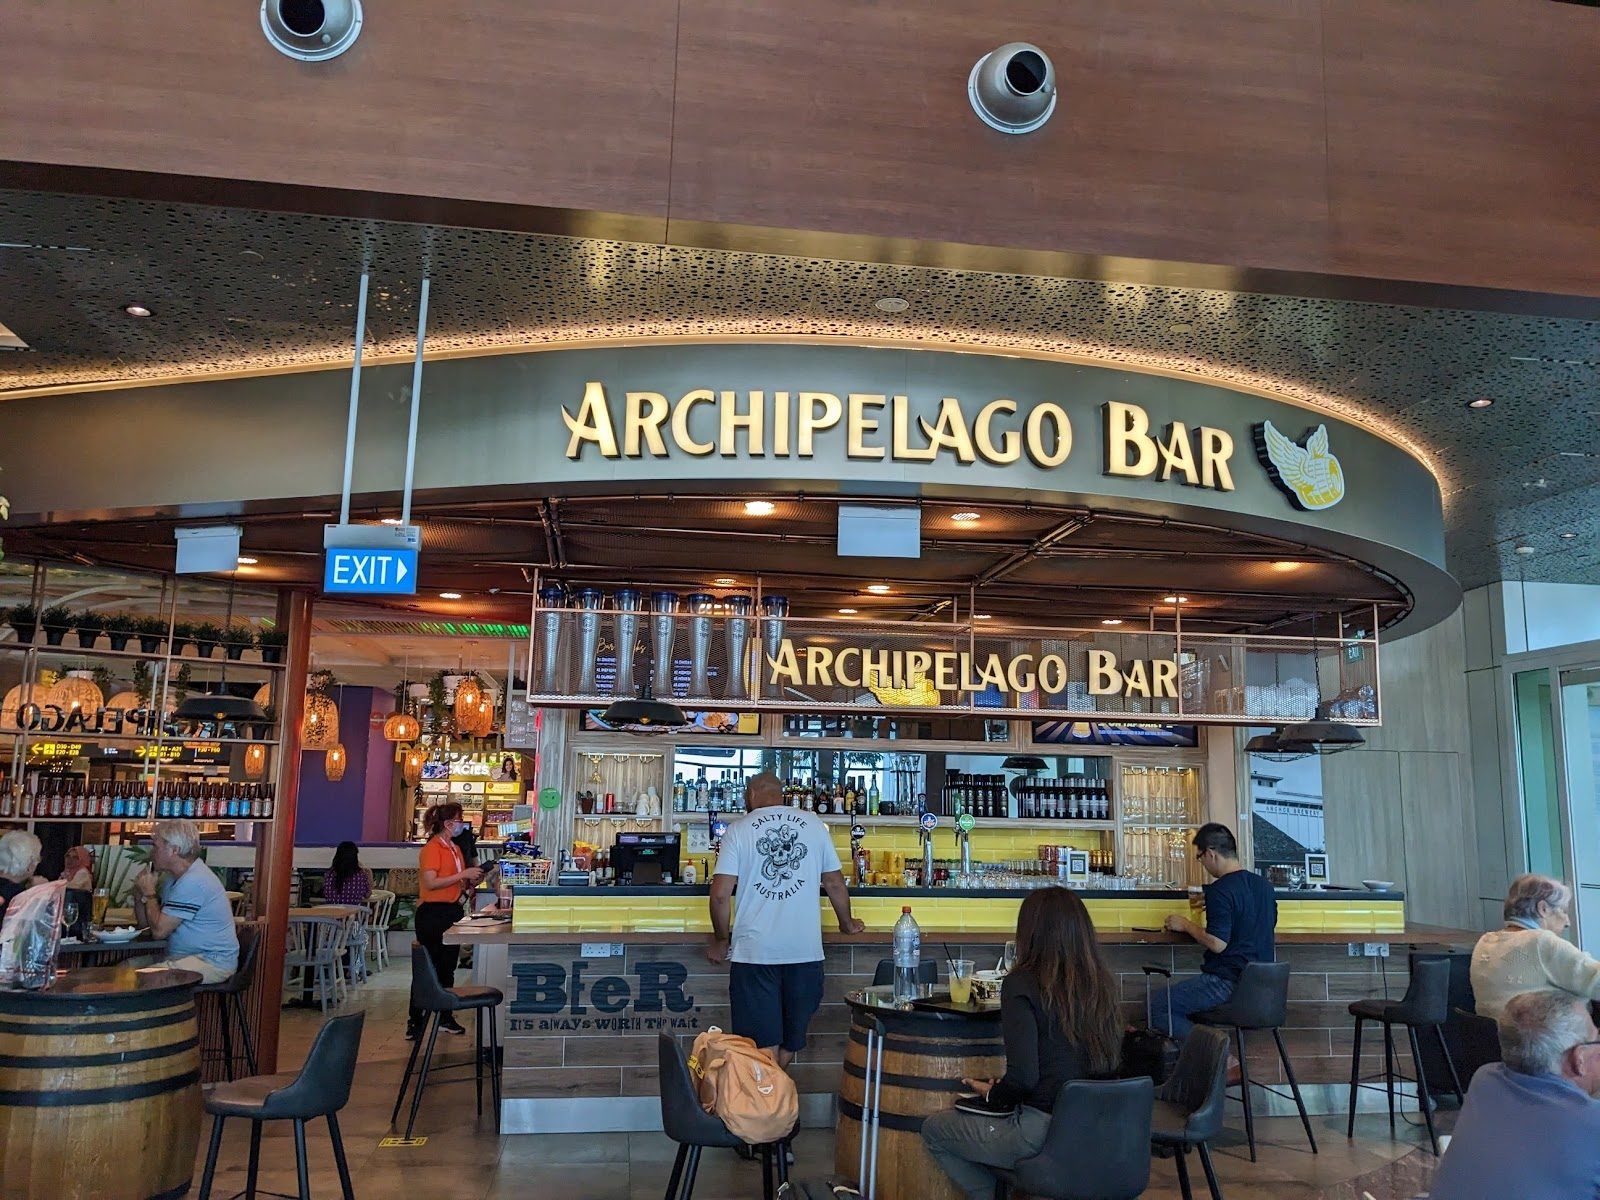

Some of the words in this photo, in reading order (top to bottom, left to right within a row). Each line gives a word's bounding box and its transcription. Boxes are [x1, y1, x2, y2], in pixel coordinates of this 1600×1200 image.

[560, 381, 1073, 469] ARCHIPELAGO
[1101, 399, 1235, 492] BAR
[333, 555, 392, 584] EXIT
[766, 638, 1067, 694] ARCHIPELAGO
[1087, 649, 1179, 698] BAR
[751, 813, 783, 830] SALTY
[786, 814, 808, 829] LIFE
[753, 878, 806, 901] AUSTRALIA
